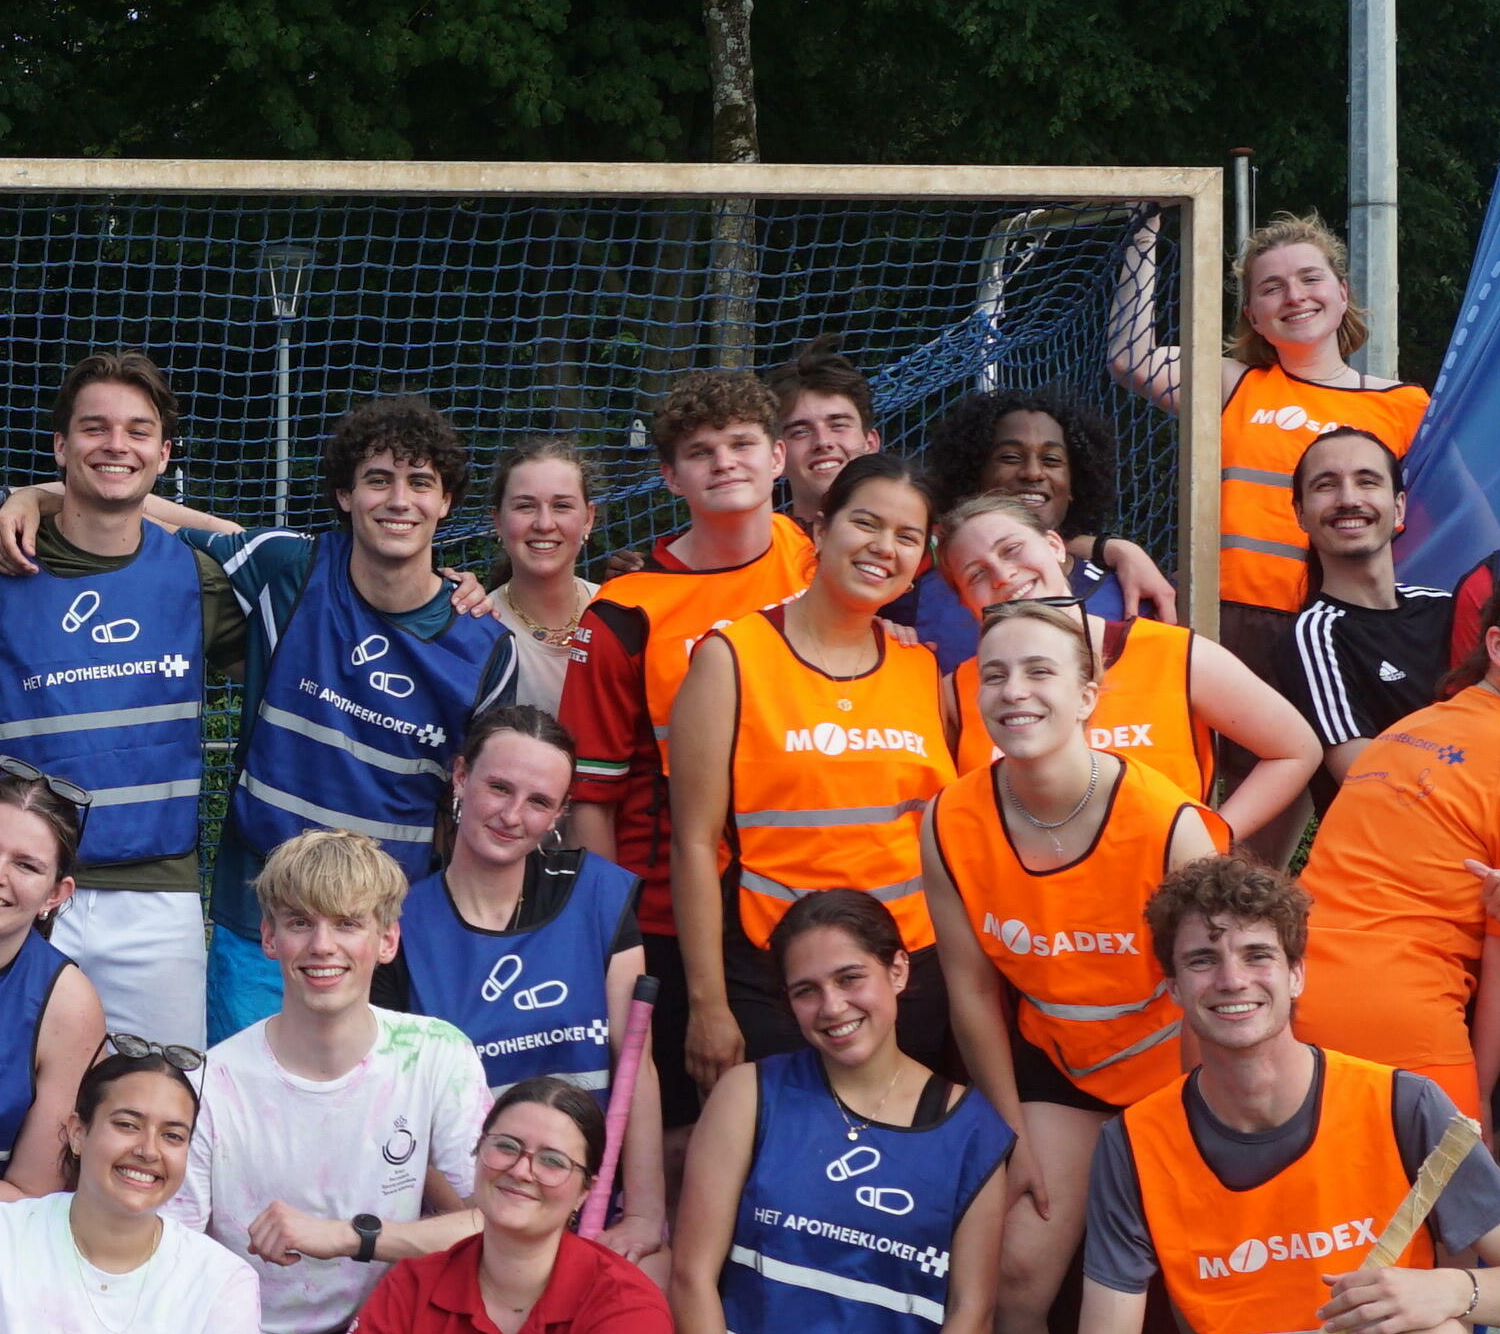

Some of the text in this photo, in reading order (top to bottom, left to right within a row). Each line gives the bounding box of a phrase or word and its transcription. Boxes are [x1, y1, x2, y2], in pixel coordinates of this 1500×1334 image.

[1250, 405, 1349, 434] MOSA
[23, 661, 158, 691] HET APOTHEEKLOKET
[300, 678, 319, 695] HET
[475, 1026, 587, 1059] POTHEEKLOKET
[754, 1207, 918, 1262] HET APOTHEEKLOKET
